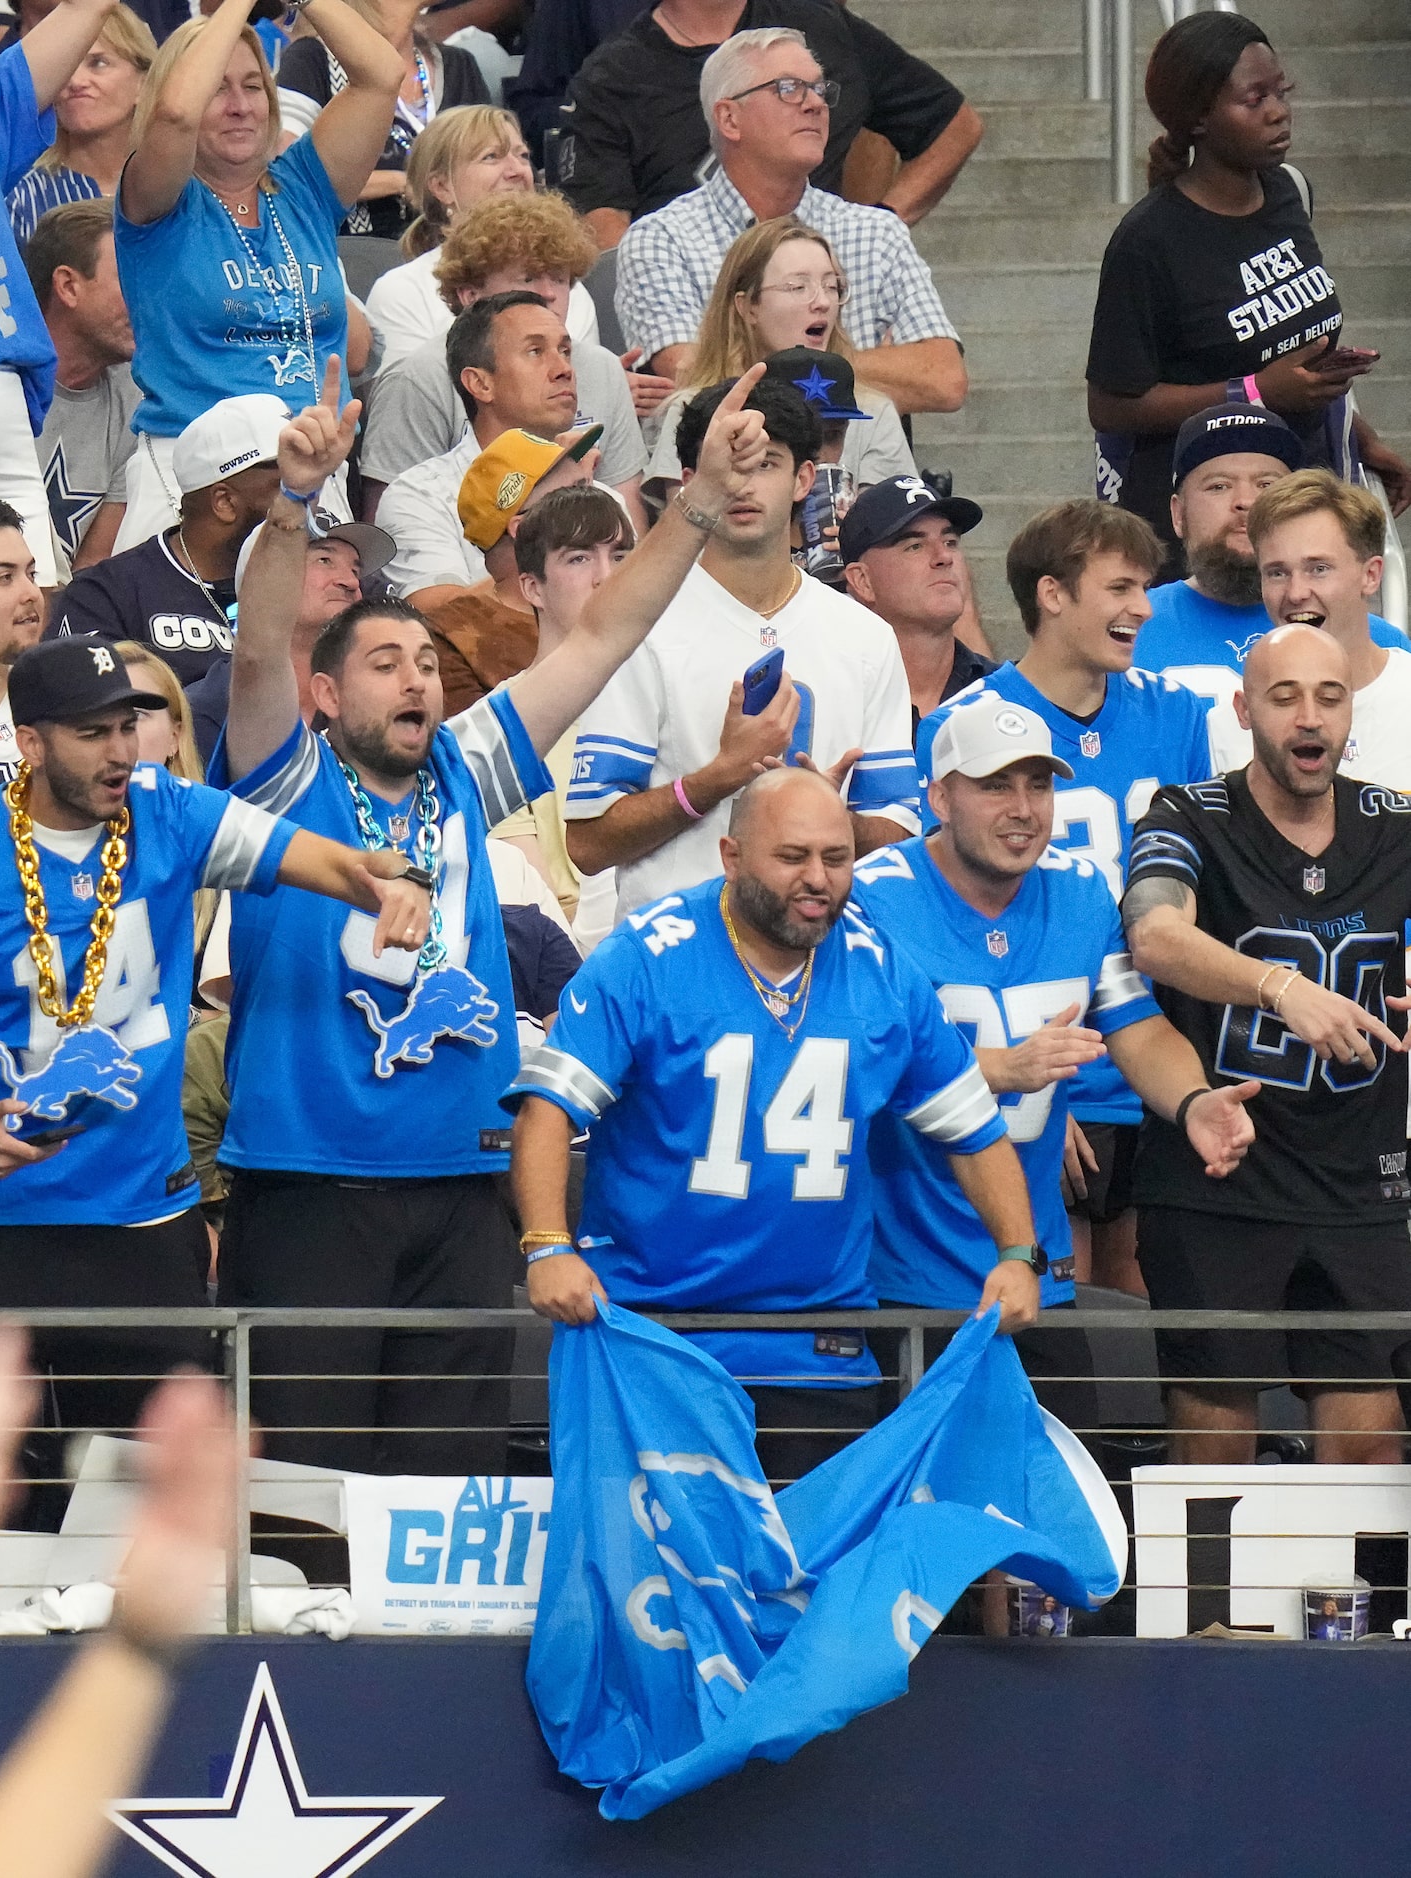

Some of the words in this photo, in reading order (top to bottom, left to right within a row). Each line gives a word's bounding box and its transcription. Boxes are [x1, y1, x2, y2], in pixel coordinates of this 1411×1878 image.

[1240, 238, 1304, 295] AT&T
[1261, 347, 1272, 362] IN
[1277, 334, 1301, 354] SEAT
[219, 449, 260, 473] COWBOYS
[1215, 927, 1399, 1093] 20
[687, 1033, 854, 1201] 14
[385, 1599, 417, 1608] DETROIT
[419, 1600, 428, 1608] VS
[430, 1600, 456, 1609] TAMPA
[458, 1601, 471, 1609] BAY
[477, 1602, 509, 1610] JANUARY
